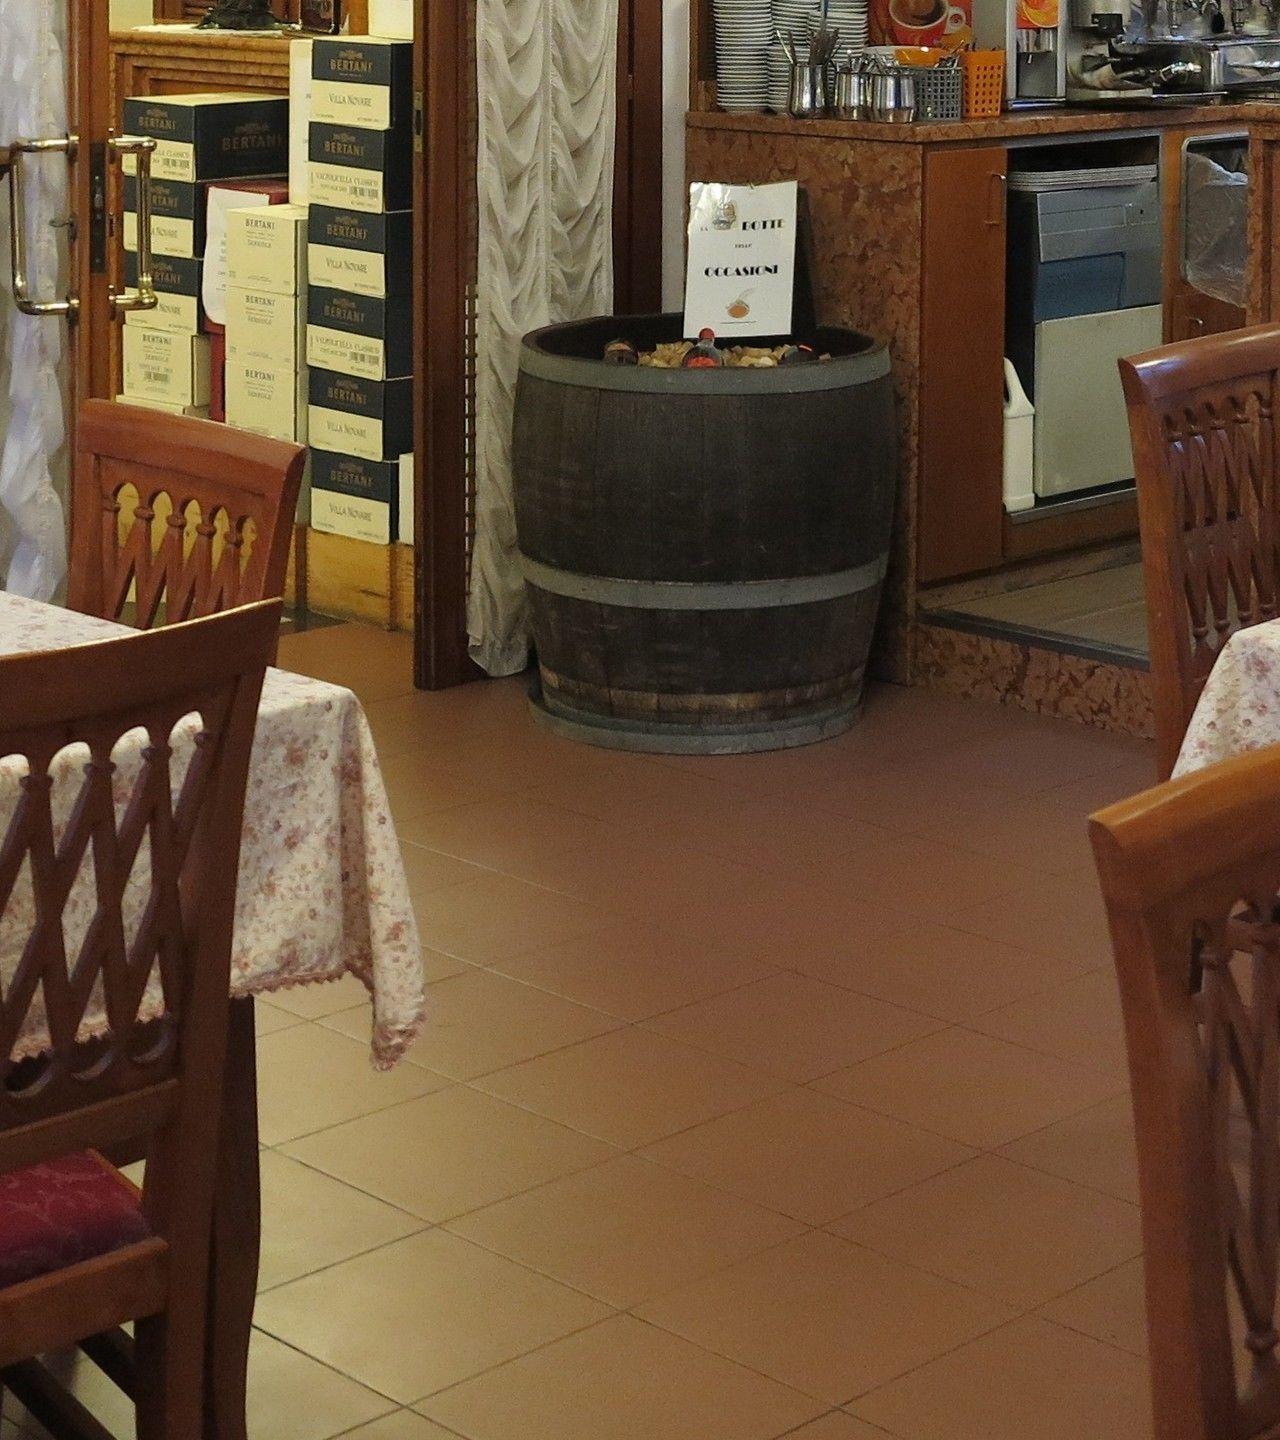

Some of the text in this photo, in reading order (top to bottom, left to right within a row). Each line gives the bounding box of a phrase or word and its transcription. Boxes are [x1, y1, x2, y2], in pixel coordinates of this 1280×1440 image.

[329, 58, 373, 73] BERTANI
[323, 140, 365, 156] BERTANI
[245, 219, 275, 230] BERTANI
[704, 264, 778, 277] OCCASIONI
[245, 295, 275, 306] BERTANI
[142, 334, 172, 345] BERTANI
[245, 369, 275, 381] BERTANI
